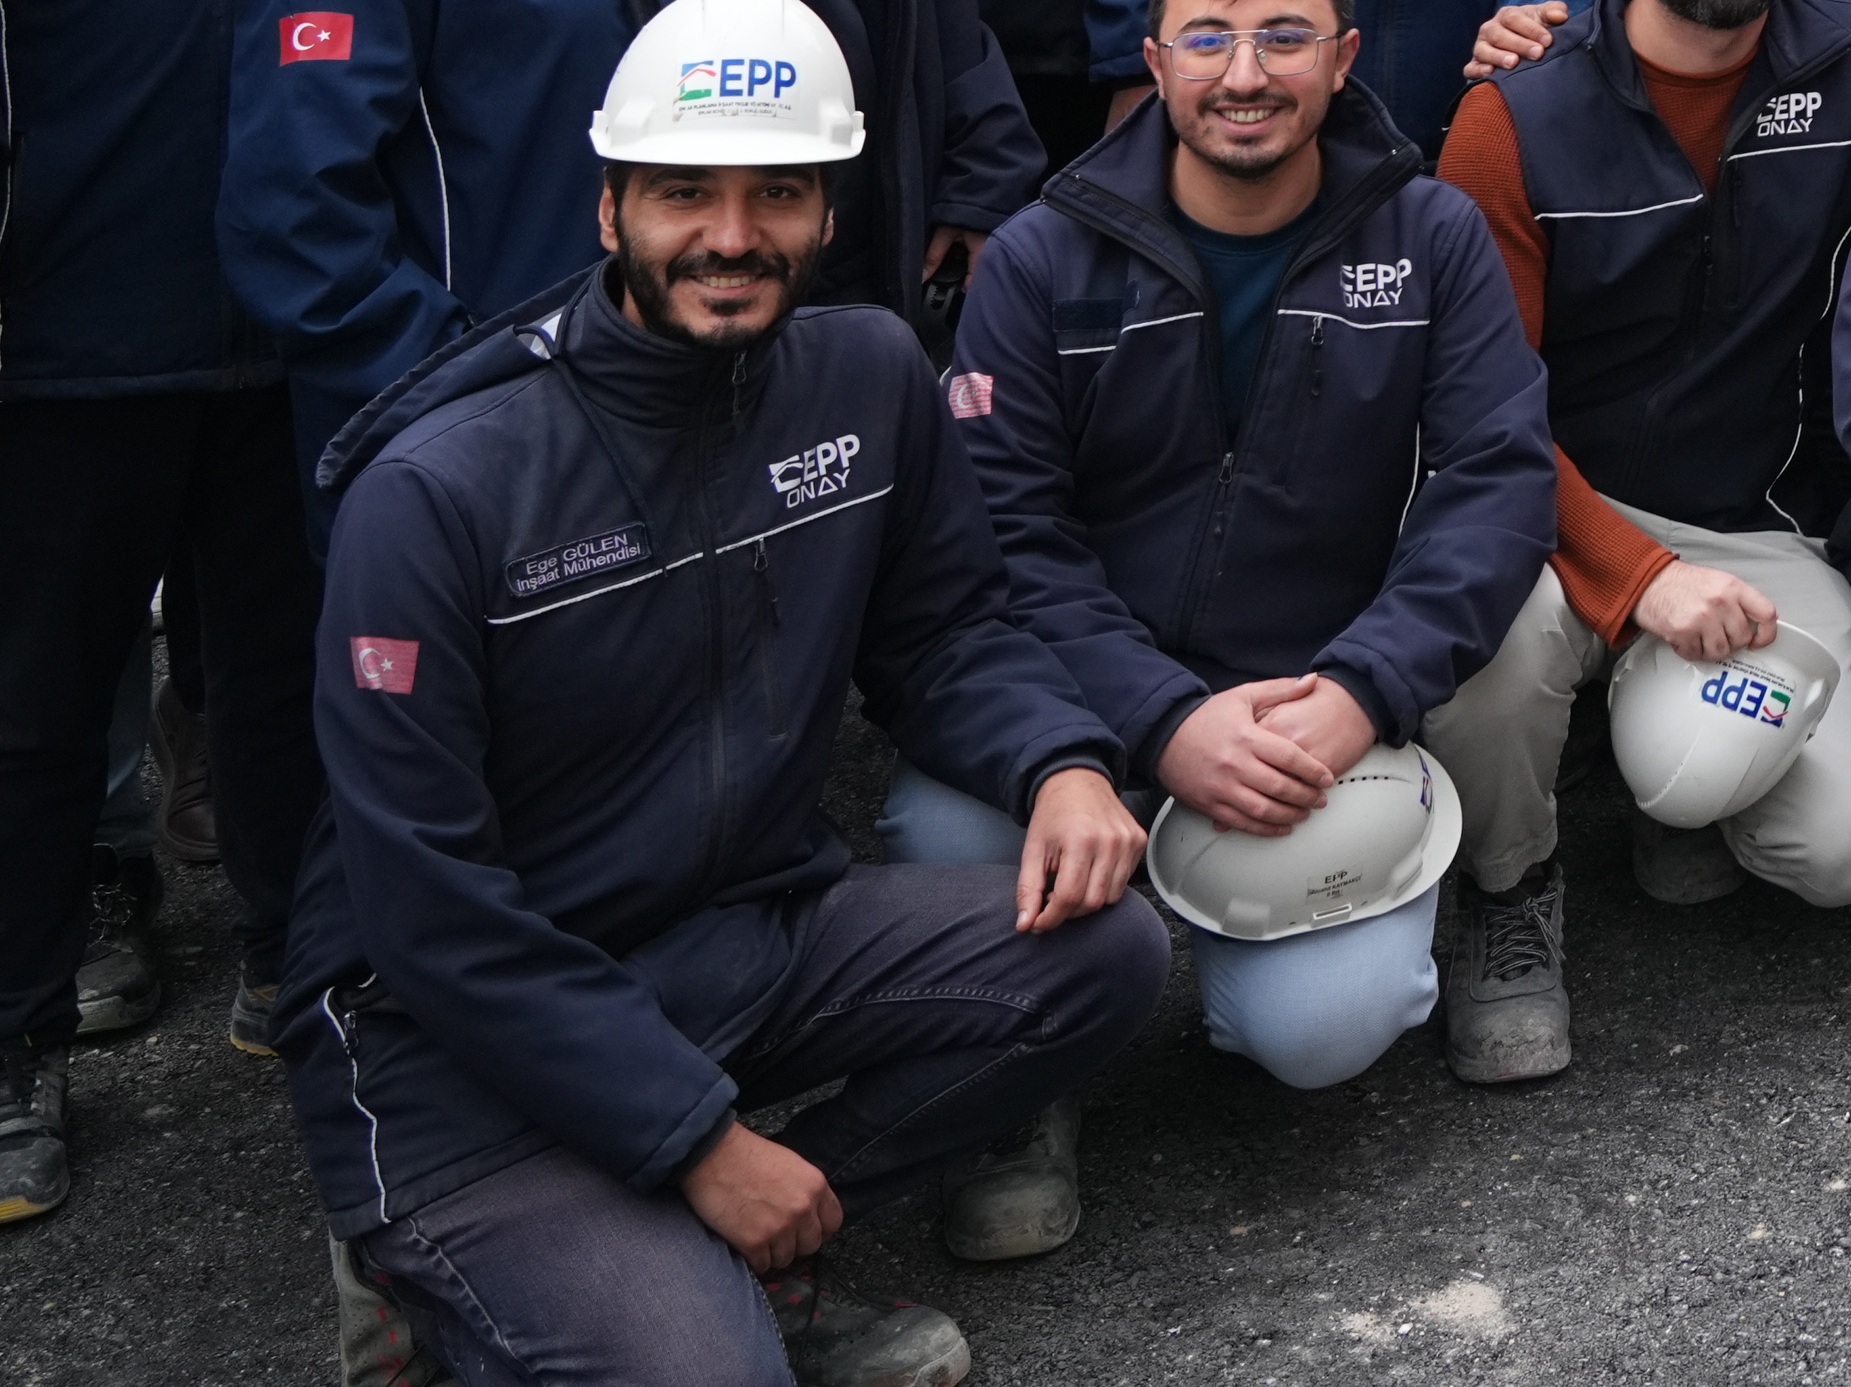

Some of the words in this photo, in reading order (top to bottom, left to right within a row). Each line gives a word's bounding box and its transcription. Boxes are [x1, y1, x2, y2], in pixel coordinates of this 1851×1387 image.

[720, 59, 797, 99] EPP
[1773, 92, 1823, 121] EPP
[1757, 118, 1814, 137] ONAY
[1356, 258, 1412, 291] EPP
[801, 434, 860, 480] EPP
[786, 468, 850, 509] ONAY
[526, 556, 559, 579] Ege
[563, 533, 629, 564] GÜLEN
[563, 545, 642, 580] Mühendisi
[1701, 671, 1768, 719] EPP
[1325, 871, 1348, 884] EPP
